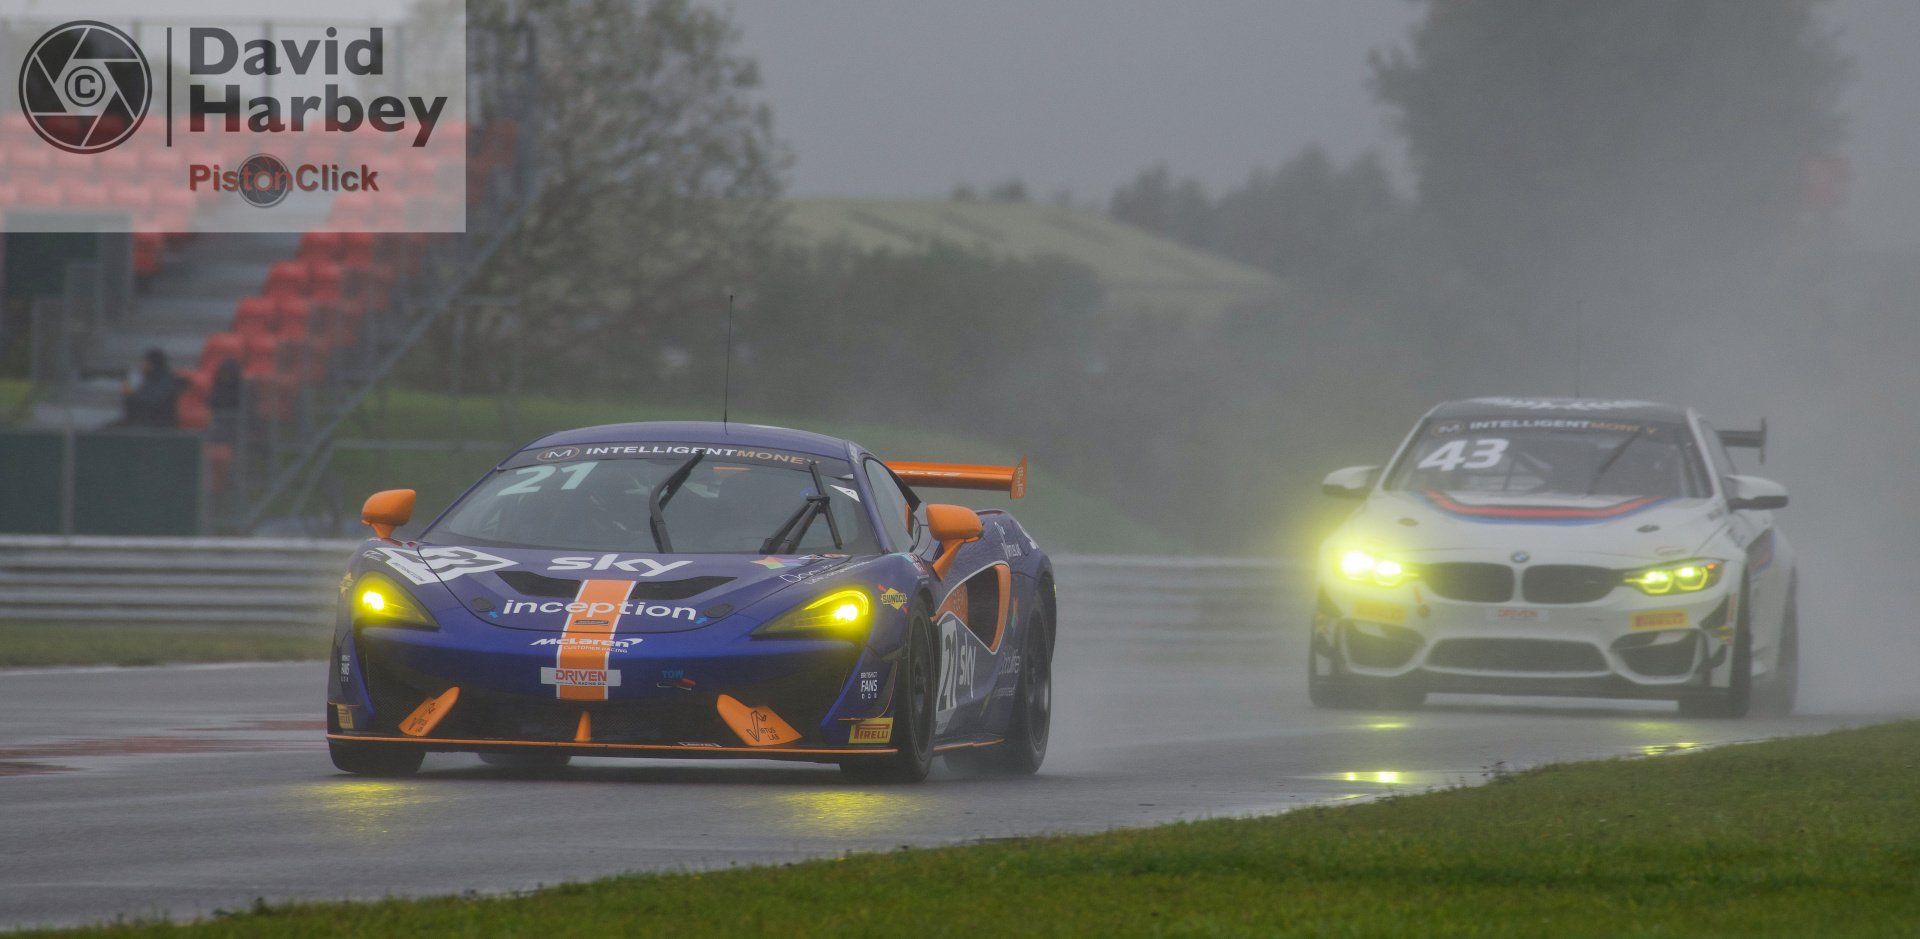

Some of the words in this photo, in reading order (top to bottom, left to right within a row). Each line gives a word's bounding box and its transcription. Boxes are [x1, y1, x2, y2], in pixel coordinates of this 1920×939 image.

[1418, 438, 1510, 472] 43
[497, 461, 599, 497] 21
[547, 554, 694, 577] sky
[502, 599, 697, 621] inception
[530, 637, 629, 648] McLaren
[959, 632, 977, 699] sky
[555, 670, 608, 684] DRIVEN
[860, 680, 878, 692] FANS
[854, 724, 890, 739] PIRELLI
